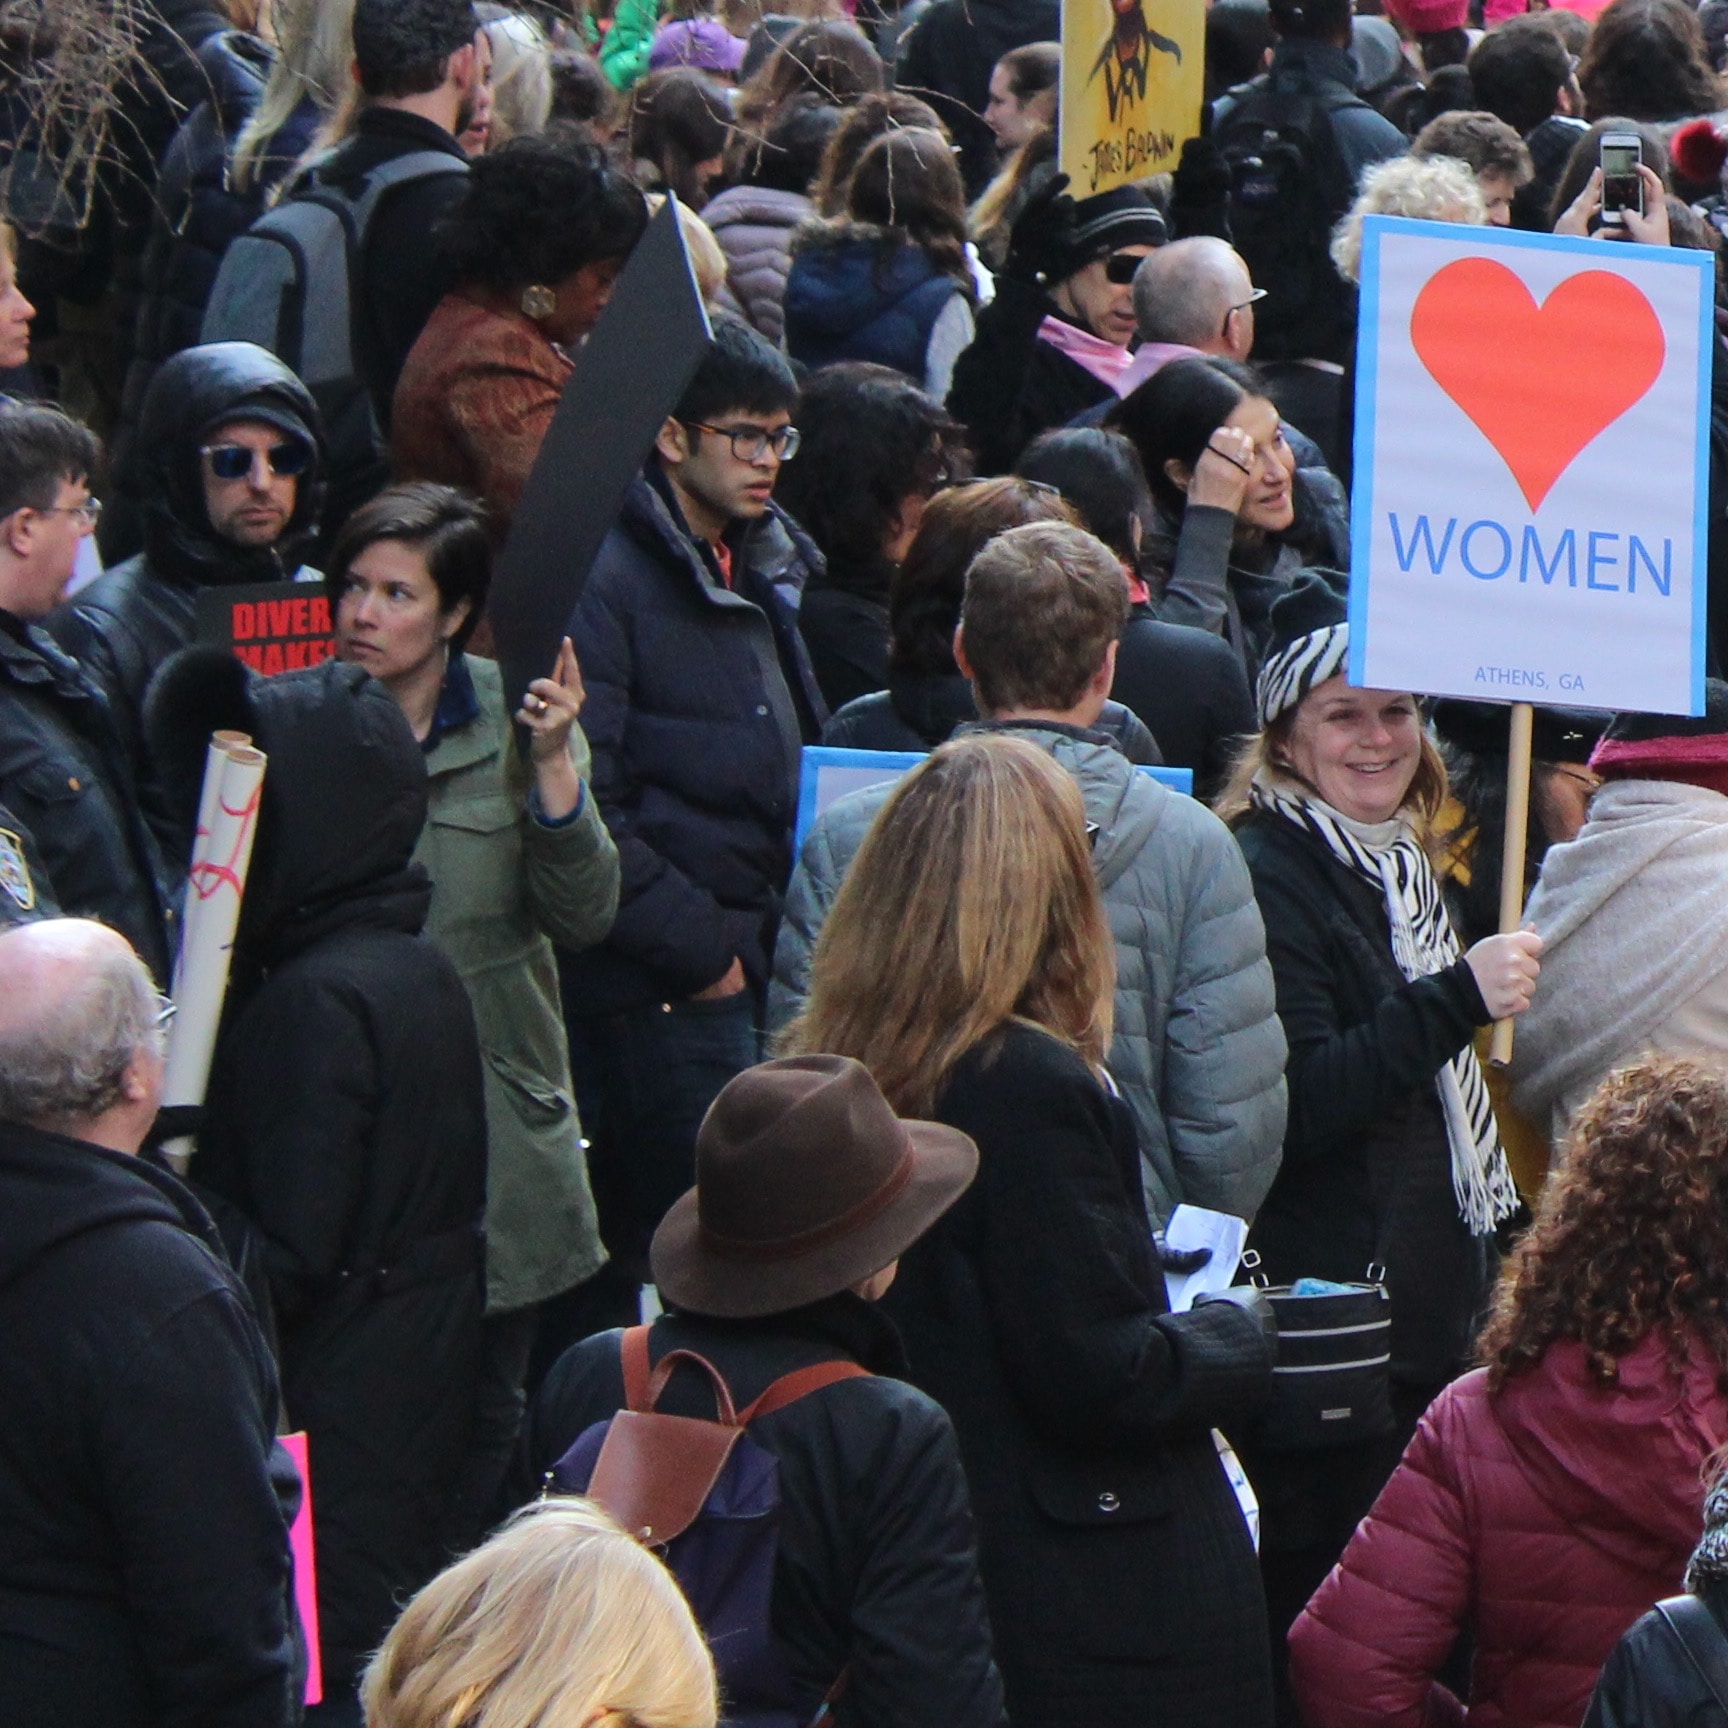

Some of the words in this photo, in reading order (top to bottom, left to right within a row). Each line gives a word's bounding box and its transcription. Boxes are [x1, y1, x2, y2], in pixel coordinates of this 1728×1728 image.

[1124, 126, 1175, 174] BALDWIN
[1388, 511, 1672, 597] WOMEN
[231, 596, 333, 641] DIVER
[1474, 666, 1550, 691] ATHENS,
[1558, 672, 1585, 692] GA
